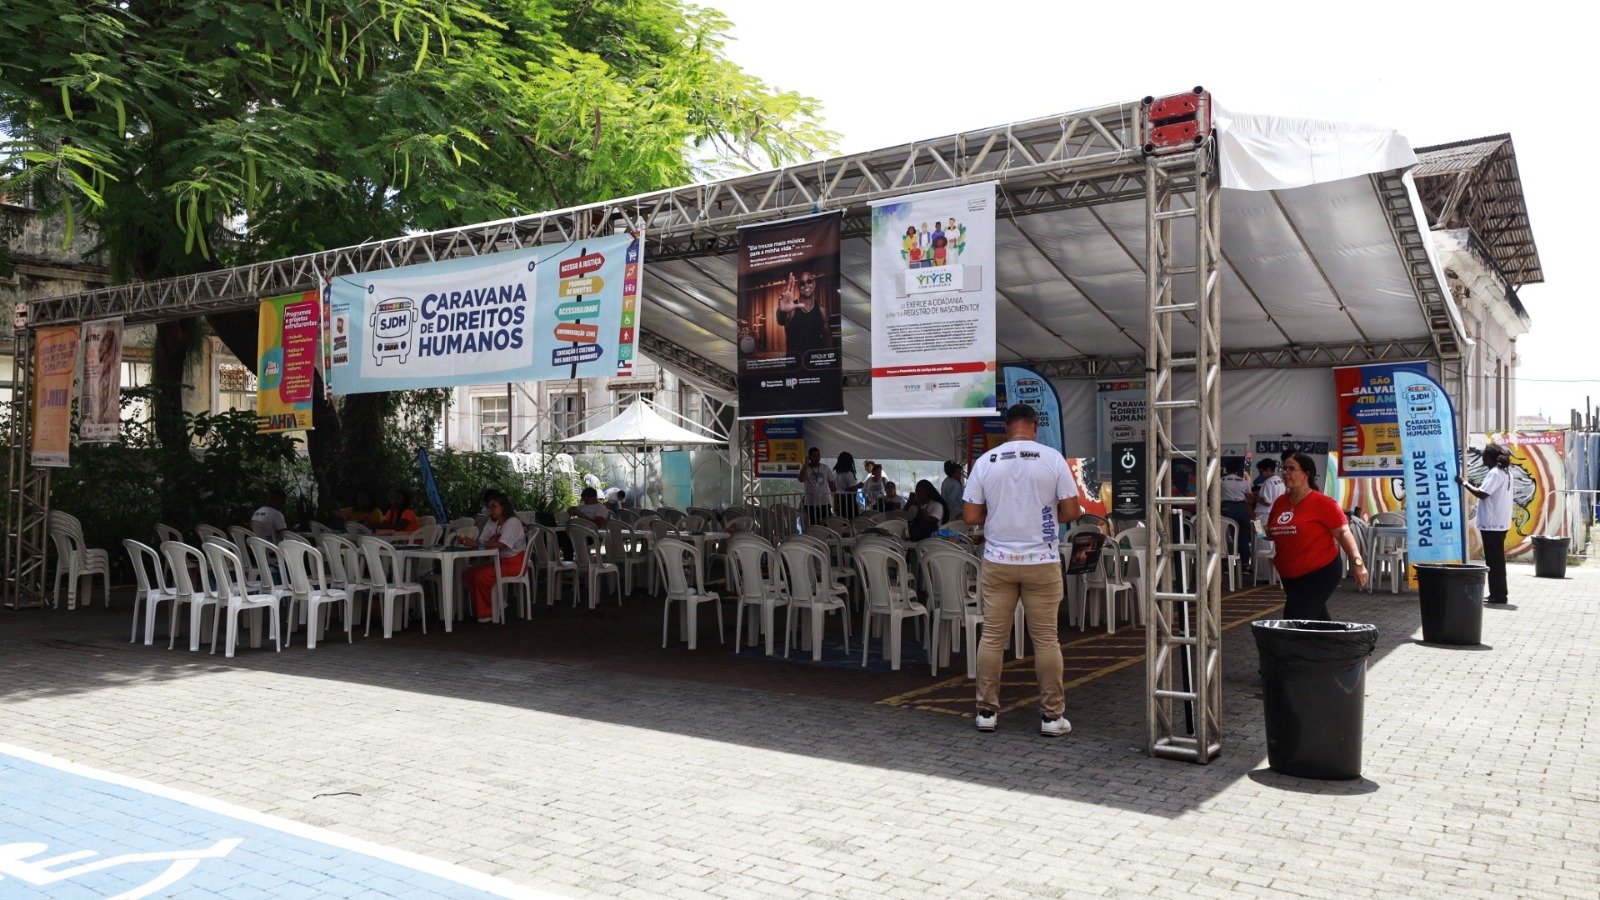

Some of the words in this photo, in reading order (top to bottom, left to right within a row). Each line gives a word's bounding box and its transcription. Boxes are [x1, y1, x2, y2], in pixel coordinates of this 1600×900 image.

[562, 262, 578, 272] ACESSO
[579, 260, 583, 269] À
[583, 258, 602, 268] JUSTIÇA
[916, 272, 952, 284] VIVER
[421, 283, 527, 320] CARAVANA
[906, 300, 926, 308] EXERCE
[932, 297, 963, 306] CIDADANIA
[559, 304, 598, 315] ACESSIBILIDADE
[904, 308, 930, 316] REGISTRO
[380, 315, 406, 331] SJDH
[420, 322, 434, 334] DE
[436, 305, 526, 334] DIREITOS
[418, 327, 524, 357] HUMANOS
[1370, 376, 1391, 385] SÃO
[1352, 385, 1395, 395] SALVAD
[1110, 401, 1146, 410] CARAVA
[1406, 419, 1440, 427] CARAVANA
[1412, 451, 1429, 496] LIVRE
[1434, 461, 1452, 517] CIPTEA
[1417, 500, 1433, 547] PASSE
[1440, 521, 1453, 530] E
